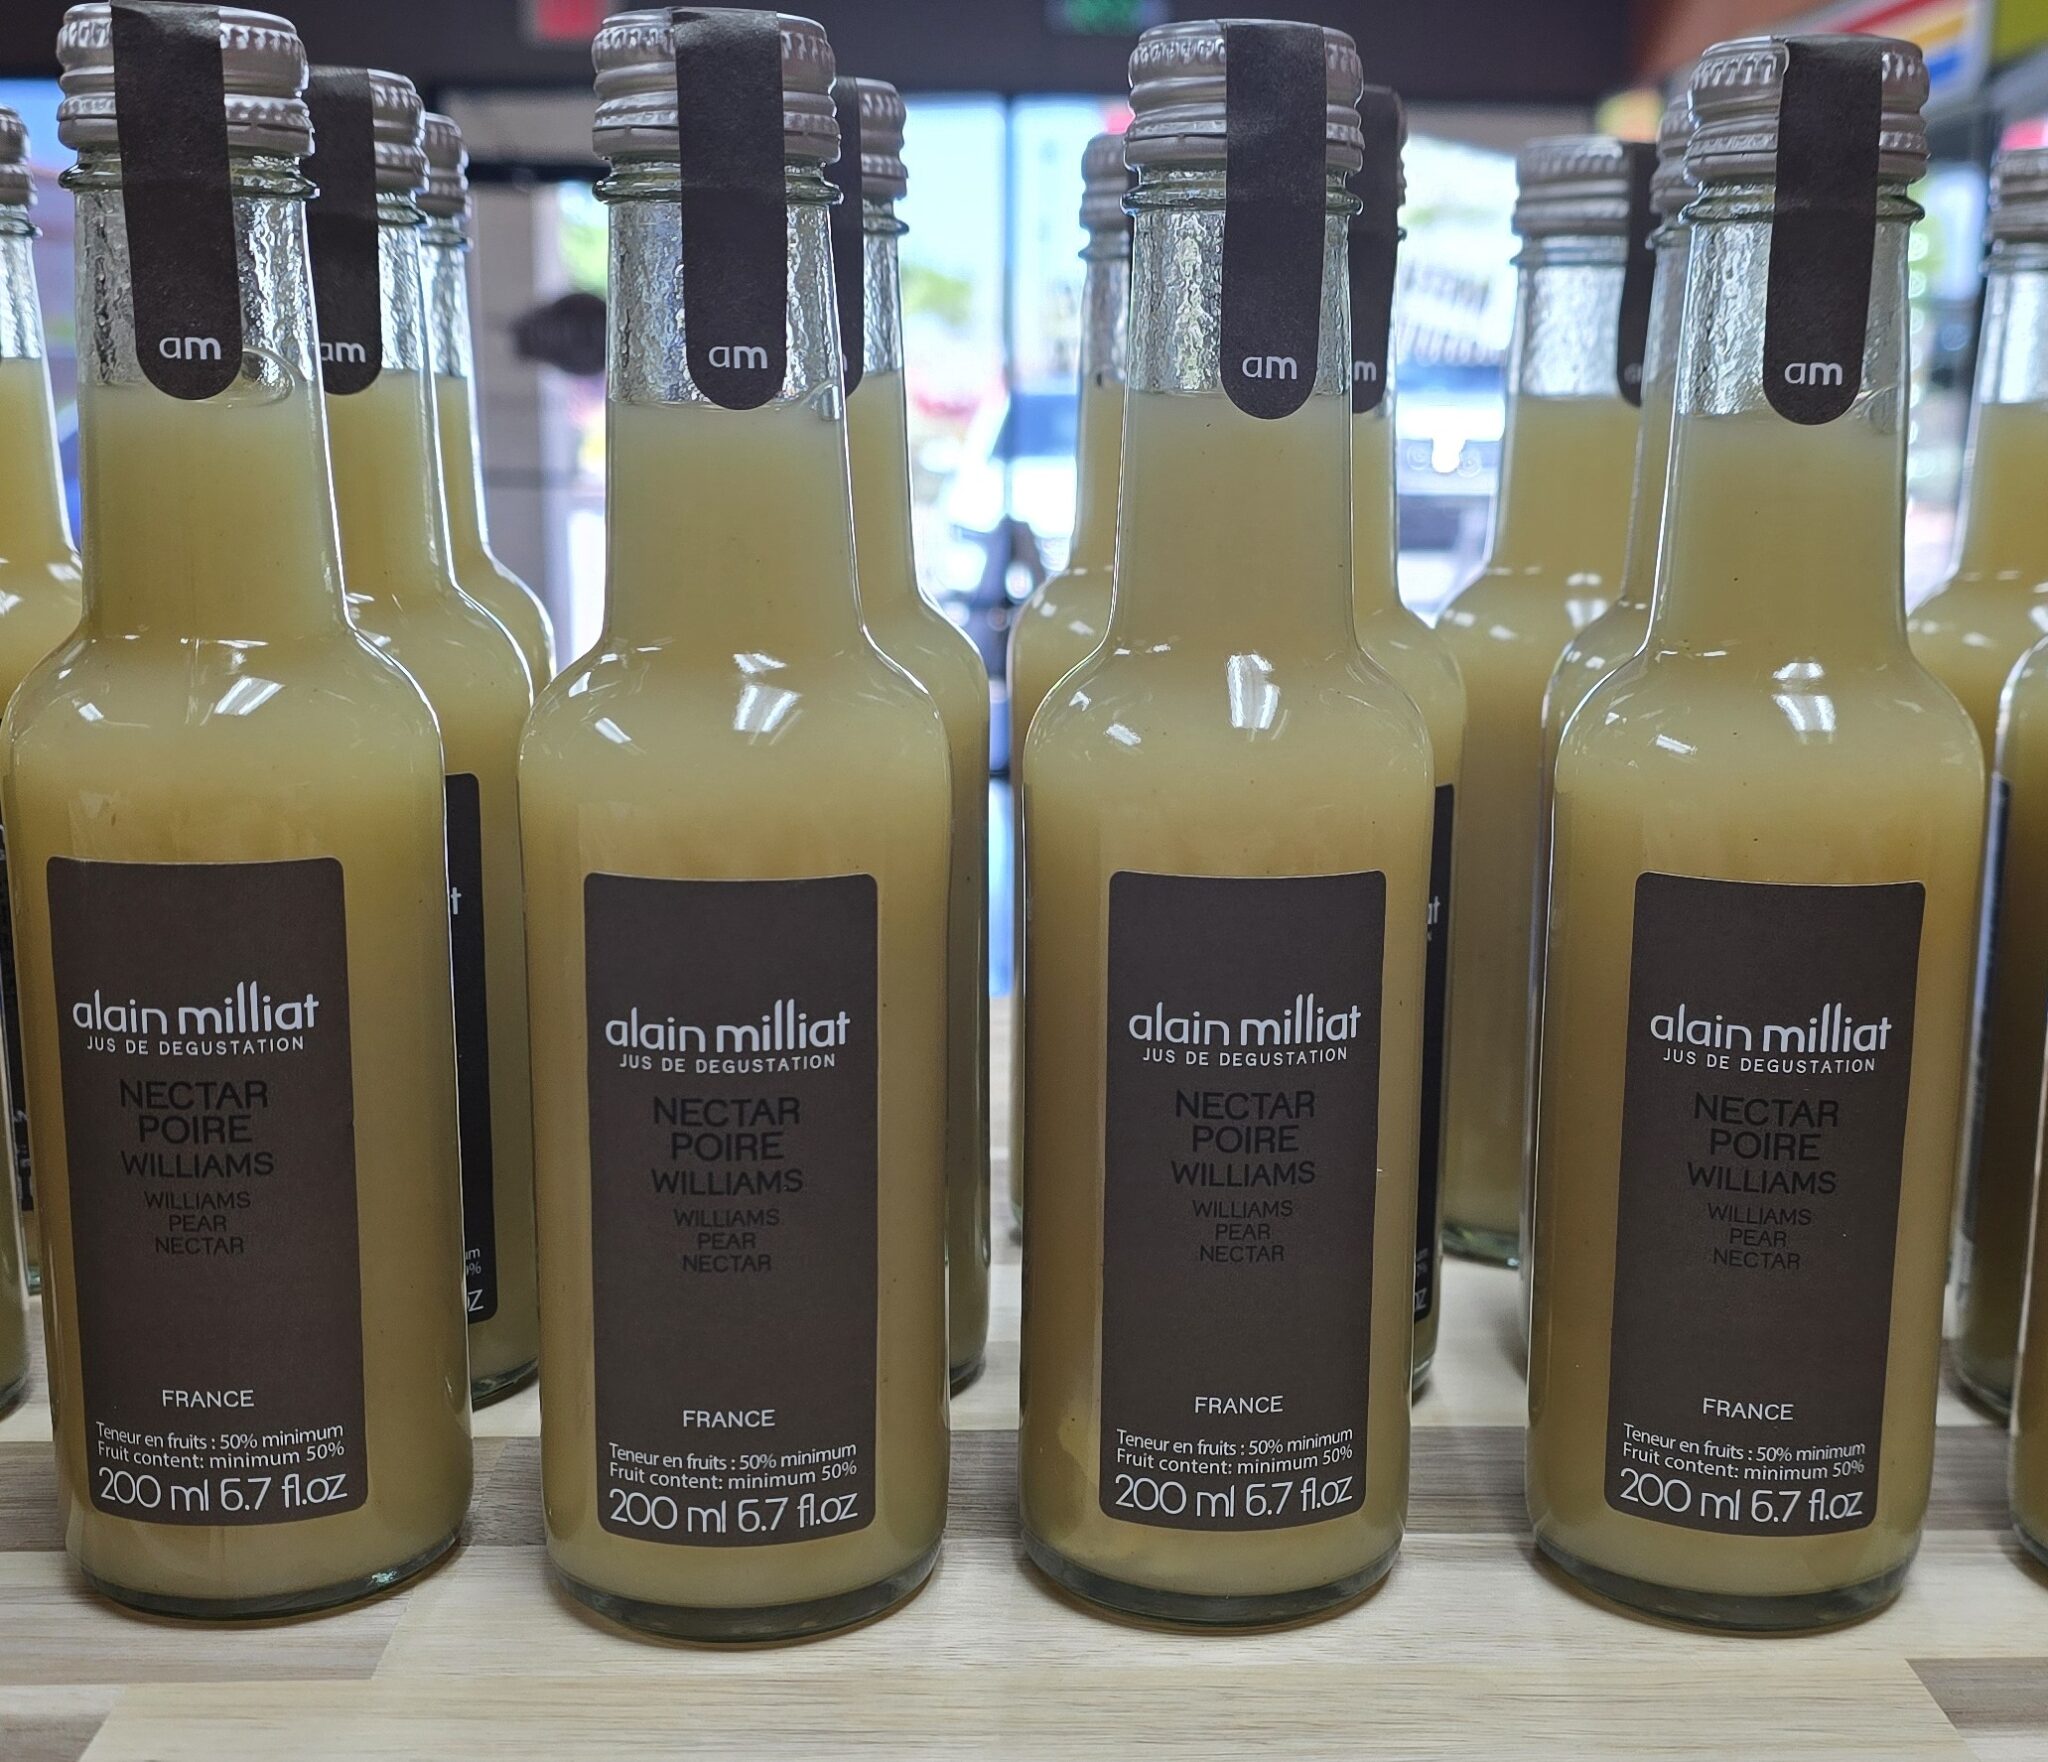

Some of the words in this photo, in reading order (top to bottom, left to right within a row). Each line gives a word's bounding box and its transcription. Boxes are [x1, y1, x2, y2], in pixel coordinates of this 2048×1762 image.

[160, 337, 221, 359] am
[709, 346, 767, 368] am
[1243, 356, 1297, 379] am
[1785, 363, 1842, 385] am
[73, 990, 167, 1034] alain
[179, 981, 319, 1034] milliat
[1129, 1002, 1229, 1045] alain
[1241, 993, 1361, 1045] milliat
[606, 1007, 705, 1052] alain
[717, 999, 850, 1052] milliat
[1651, 1004, 1751, 1051] alain
[1763, 1003, 1891, 1052] milliat
[87, 1037, 115, 1052] JUS
[126, 1040, 148, 1054] DE
[160, 1036, 303, 1055] DEGUSTATION
[1143, 1048, 1174, 1063] JUS
[1186, 1051, 1208, 1065] DE
[1220, 1047, 1346, 1066] DEGUSTATION
[620, 1054, 651, 1069] JUS
[662, 1058, 685, 1072] DE
[696, 1054, 834, 1073] DEGUSTATION
[1664, 1048, 1695, 1064] JUS
[1707, 1054, 1729, 1069] DE
[1741, 1058, 1874, 1073] DEGUSTATION
[120, 1079, 267, 1110] NECTAR
[1176, 1090, 1315, 1120] NECTAR
[654, 1097, 799, 1127] NECTAR
[1695, 1093, 1839, 1128] NECTAR
[139, 1115, 252, 1144] POIRE
[1193, 1125, 1299, 1154] POIRE
[672, 1132, 784, 1161] POIRE
[1711, 1128, 1821, 1161] POIRE
[121, 1151, 273, 1178] WILLIAMS
[1171, 1161, 1315, 1187] WILLIAMS
[651, 1169, 803, 1195] WILLIAMS
[1688, 1162, 1836, 1194] WILLIAMS
[144, 1191, 250, 1210] WILLIAMS
[1193, 1200, 1292, 1218] WILLIAMS
[169, 1215, 226, 1232] PEAR
[673, 1208, 779, 1228] WILLIAMS
[1708, 1203, 1811, 1225] WILLIAMS
[698, 1232, 756, 1250] PEAR
[1216, 1223, 1270, 1240] PEAR
[1730, 1228, 1786, 1247] PEAR
[155, 1237, 243, 1255] NECTAR
[1200, 1245, 1284, 1262] NECTAR
[1714, 1248, 1800, 1270] NECTAR
[683, 1254, 771, 1273] NECTAR
[163, 1390, 254, 1407] FRANCE
[1196, 1396, 1283, 1414] FRANCE
[1704, 1398, 1793, 1420] FRANCE
[683, 1410, 775, 1427] FRANCE
[96, 1422, 141, 1444] Teneur
[145, 1436, 163, 1447] en
[168, 1433, 207, 1449] fruits
[221, 1434, 257, 1449] 50%
[263, 1426, 342, 1447] minimum
[1117, 1429, 1169, 1451] Teneur
[1173, 1442, 1192, 1453] en
[1198, 1439, 1236, 1455] fruits
[1249, 1439, 1283, 1455] 50%
[1288, 1429, 1352, 1455] minimum
[1624, 1423, 1676, 1449] Teneur
[1680, 1441, 1699, 1454] en
[1704, 1440, 1743, 1459] fruits
[1756, 1447, 1792, 1461] 50%
[1797, 1444, 1865, 1461] minimum
[99, 1441, 129, 1462] Fruit
[134, 1451, 203, 1468] content:
[210, 1452, 299, 1468] minimum
[307, 1441, 344, 1461] 50%
[609, 1443, 659, 1465] Teneur
[663, 1456, 682, 1468] en
[687, 1453, 726, 1470] fruits
[740, 1454, 776, 1470] 50%
[781, 1445, 856, 1467] minimum
[1118, 1448, 1153, 1468] Fruit
[1159, 1460, 1231, 1474] content:
[1238, 1456, 1317, 1474] minimum
[1323, 1445, 1352, 1464] 50%
[1624, 1442, 1659, 1465] Fruit
[1665, 1457, 1738, 1478] content:
[1744, 1466, 1827, 1480] minimum
[1833, 1460, 1864, 1477] 50%
[611, 1462, 644, 1483] Fruit
[650, 1469, 722, 1489] content:
[729, 1472, 815, 1489] minimum
[822, 1461, 856, 1480] 50%
[99, 1467, 161, 1508] 200
[171, 1479, 209, 1511] ml
[221, 1477, 271, 1510] 6.7
[282, 1474, 347, 1507] fl.oz
[1116, 1474, 1186, 1514] 200
[1197, 1485, 1234, 1517] ml
[1246, 1482, 1293, 1516] 6.7
[1301, 1476, 1352, 1511] fl.oz
[1621, 1468, 1691, 1512] 200
[1701, 1489, 1740, 1520] ml
[1752, 1490, 1801, 1522] 6.7
[1809, 1489, 1863, 1522] fl.oz
[610, 1489, 677, 1529] 200
[688, 1501, 726, 1532] ml
[739, 1497, 788, 1532] 6.7
[797, 1493, 857, 1528] fl.oz
